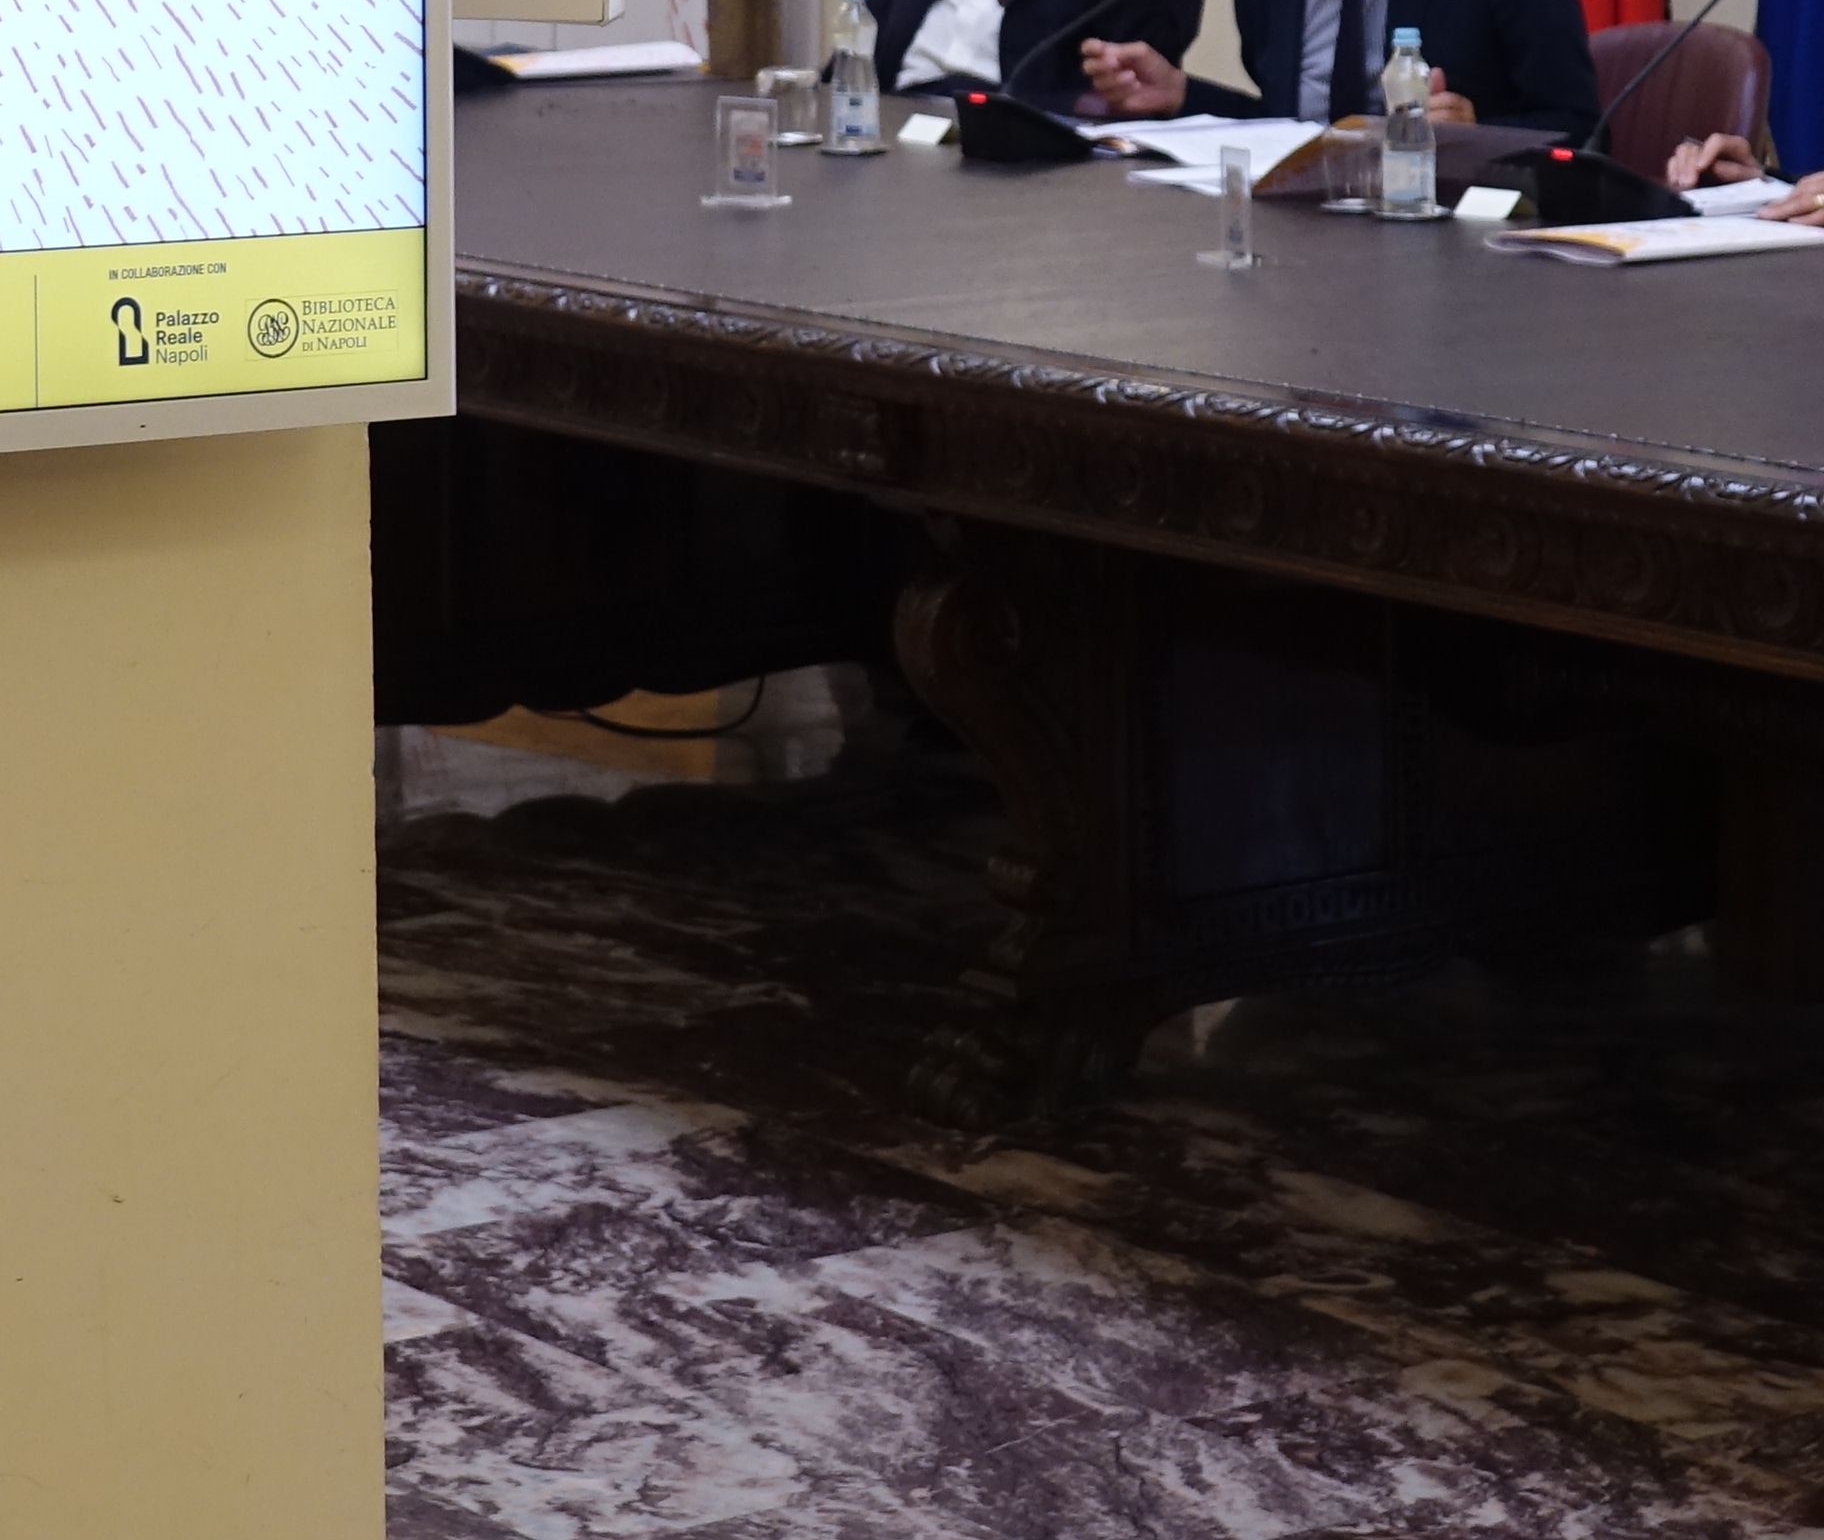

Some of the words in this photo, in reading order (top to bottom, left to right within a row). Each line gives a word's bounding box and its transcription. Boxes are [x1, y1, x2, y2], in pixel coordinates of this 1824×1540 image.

[109, 269, 119, 280] IN
[121, 264, 204, 280] COLLABORAZIONE
[207, 263, 226, 275] CON
[302, 297, 396, 316] BIBLIOTECA
[155, 310, 219, 327] Palazzo
[302, 316, 396, 335] NAZIONALE
[155, 328, 203, 346] Reale
[155, 345, 208, 366] Napoli
